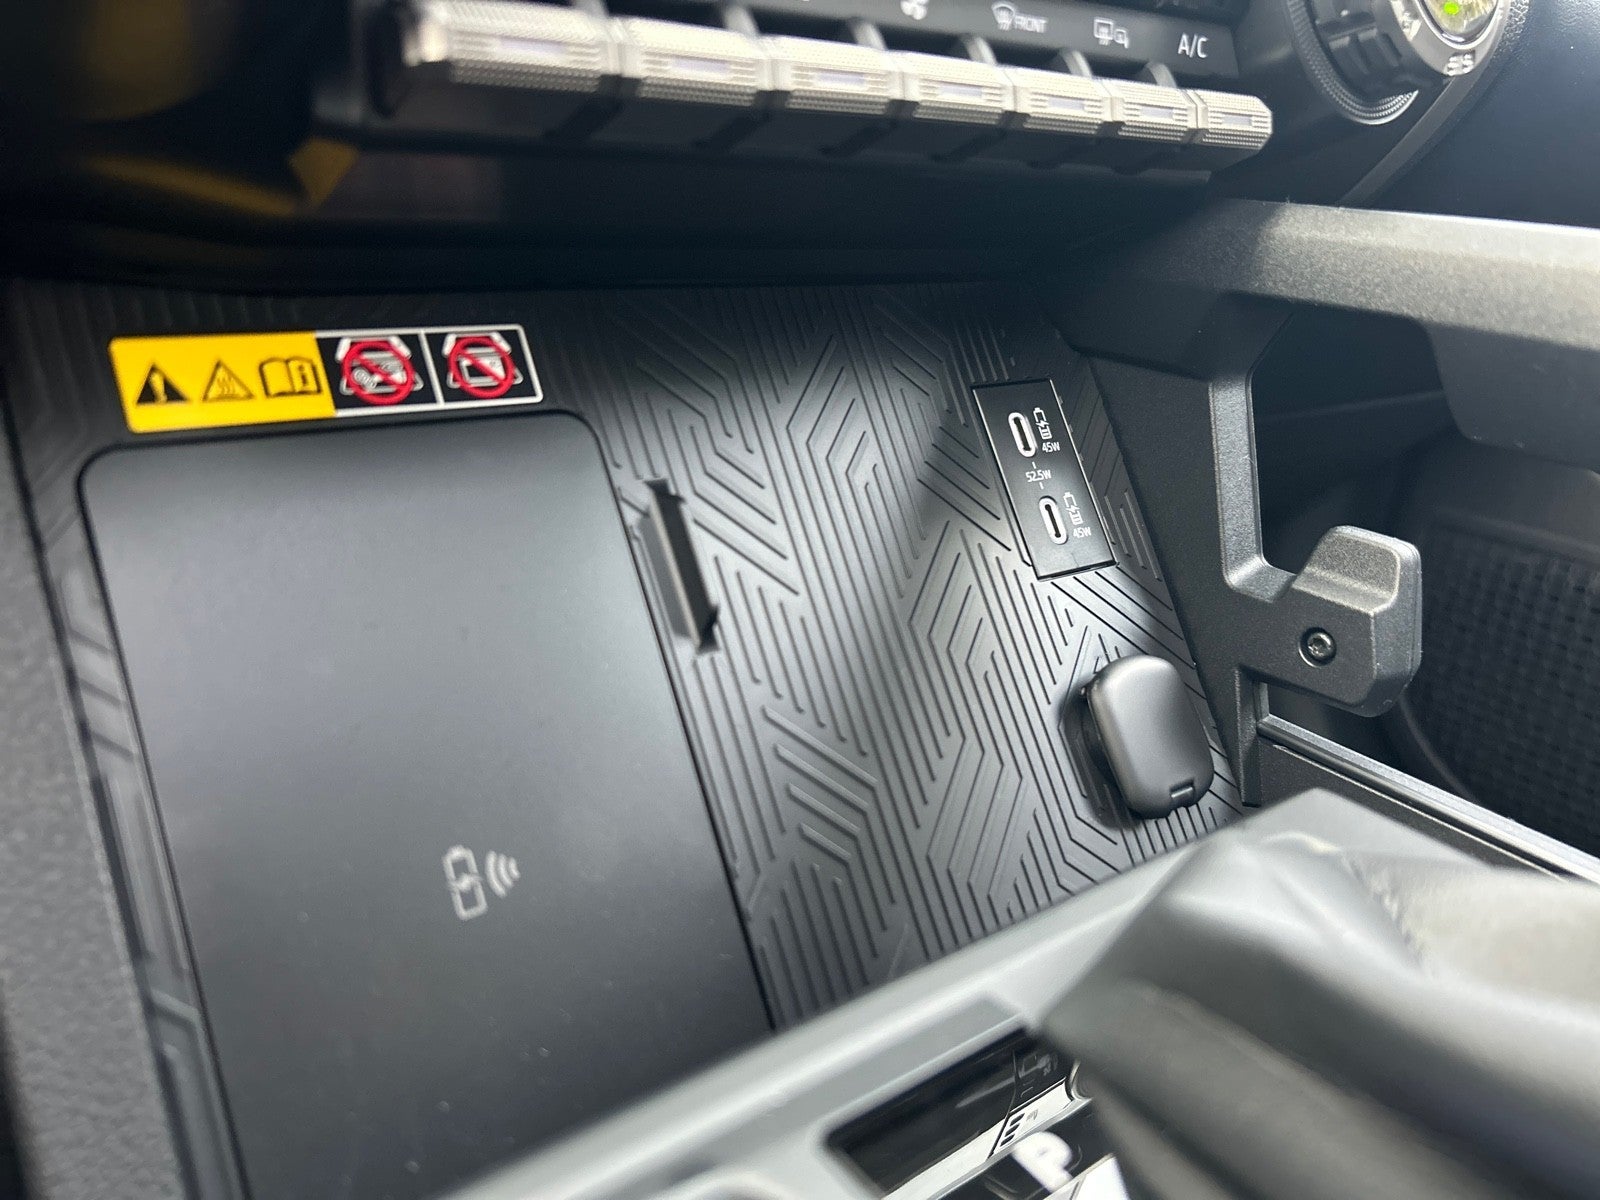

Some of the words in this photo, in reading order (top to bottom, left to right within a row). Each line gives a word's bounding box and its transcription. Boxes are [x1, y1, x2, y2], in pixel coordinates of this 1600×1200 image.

[1177, 32, 1208, 58] A/C
[1042, 441, 1061, 453] 45W
[1073, 526, 1092, 538] 45W
